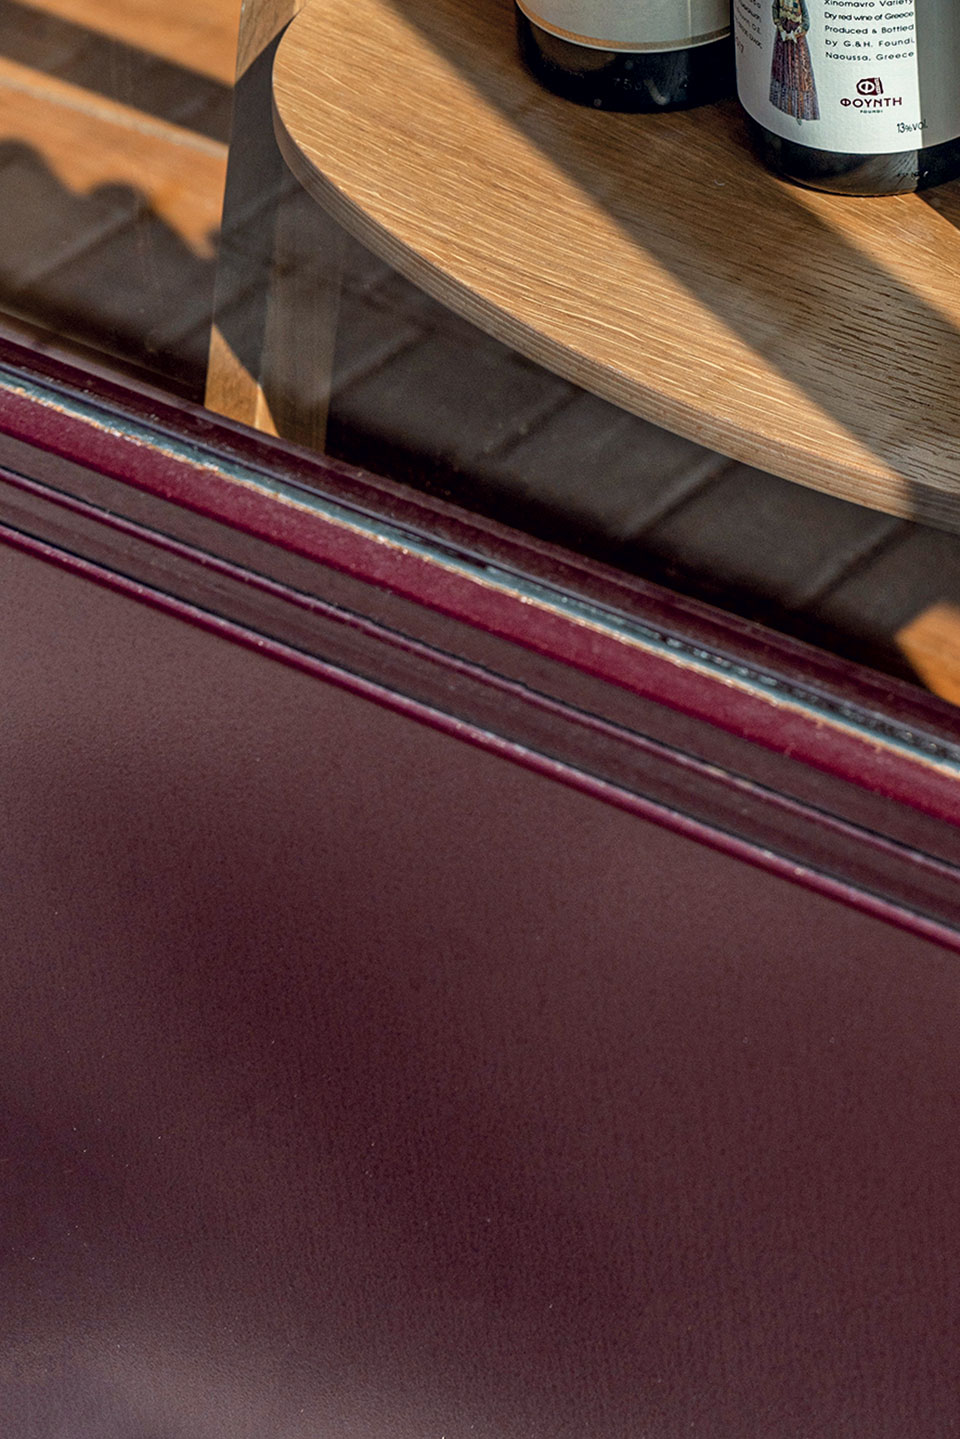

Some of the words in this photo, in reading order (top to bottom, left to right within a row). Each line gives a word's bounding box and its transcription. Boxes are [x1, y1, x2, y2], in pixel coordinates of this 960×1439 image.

[824, 11, 837, 20] Dry
[884, 11, 914, 20] Greece
[824, 24, 868, 35] Produced
[881, 24, 914, 34] Bottled
[825, 38, 838, 47] by
[876, 51, 914, 61] Greece
[840, 96, 902, 108] ΦΟΥΝΤΗ
